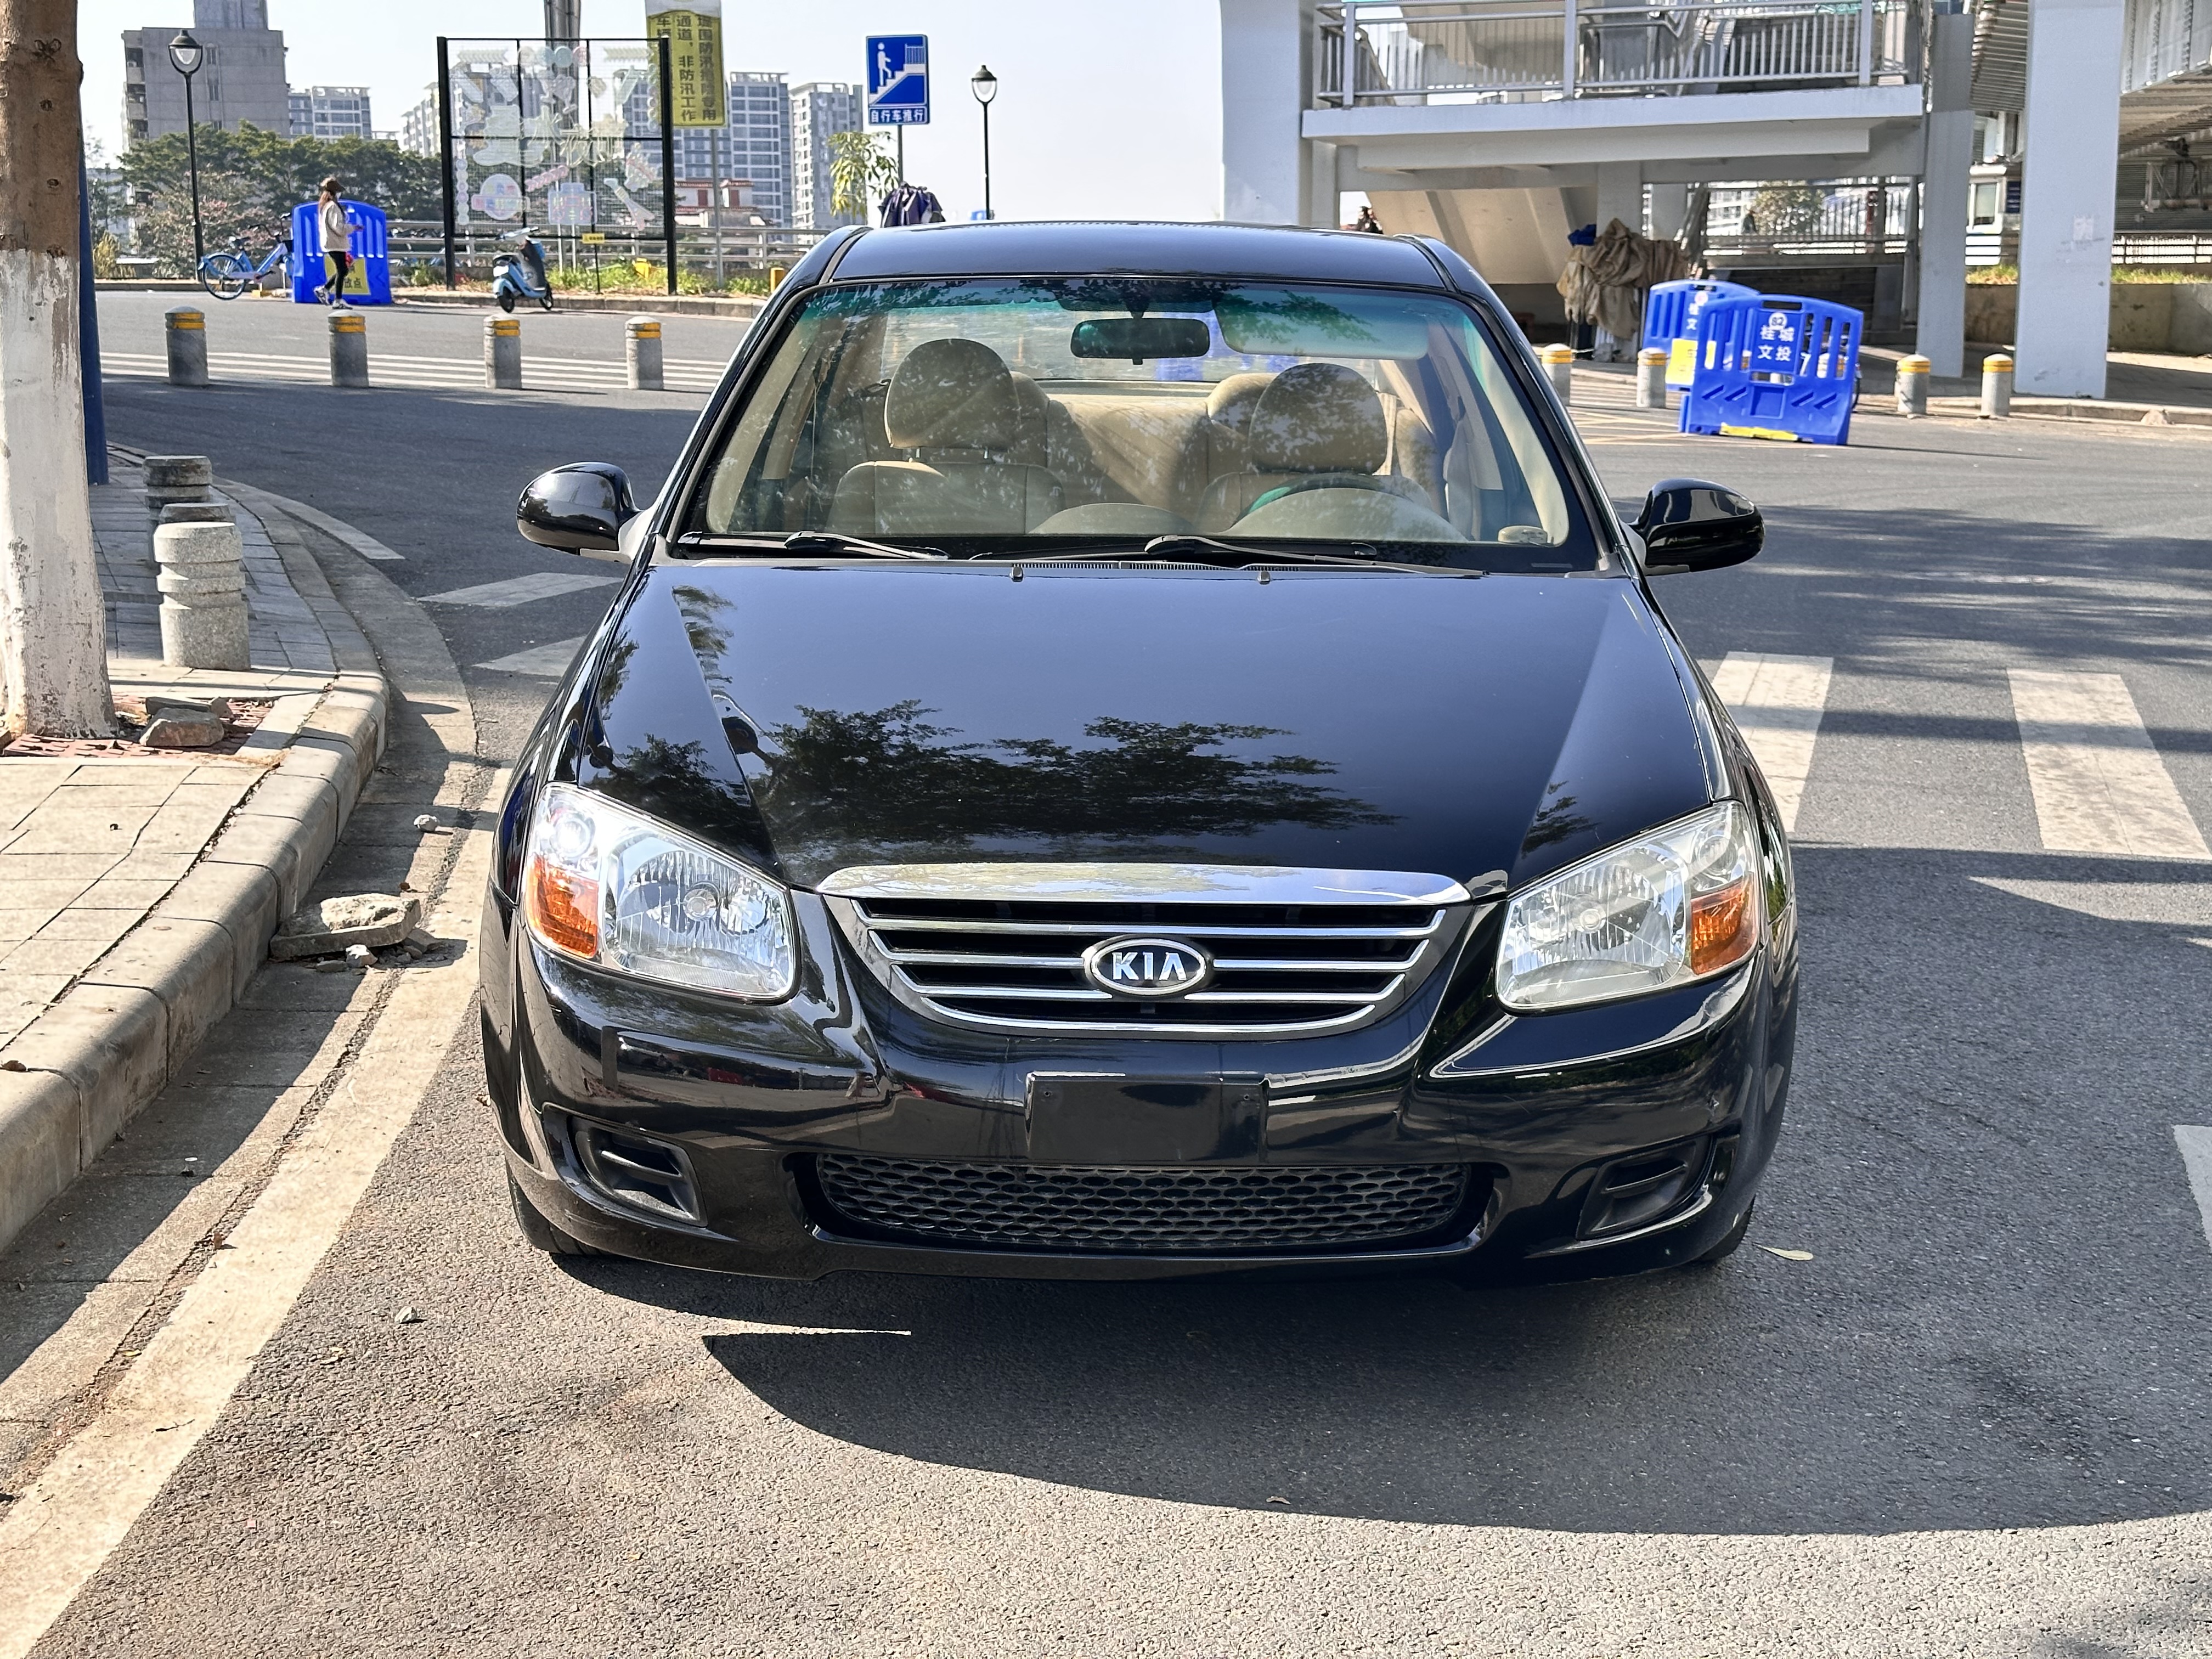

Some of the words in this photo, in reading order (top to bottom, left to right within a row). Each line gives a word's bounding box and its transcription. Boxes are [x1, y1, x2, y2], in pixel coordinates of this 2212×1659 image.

[871, 109, 923, 123] 自行车推行
[1686, 318, 1698, 330] 文
[1771, 317, 1784, 326] 82
[1757, 345, 1792, 361] 文投
[1112, 952, 1187, 981] KIA
